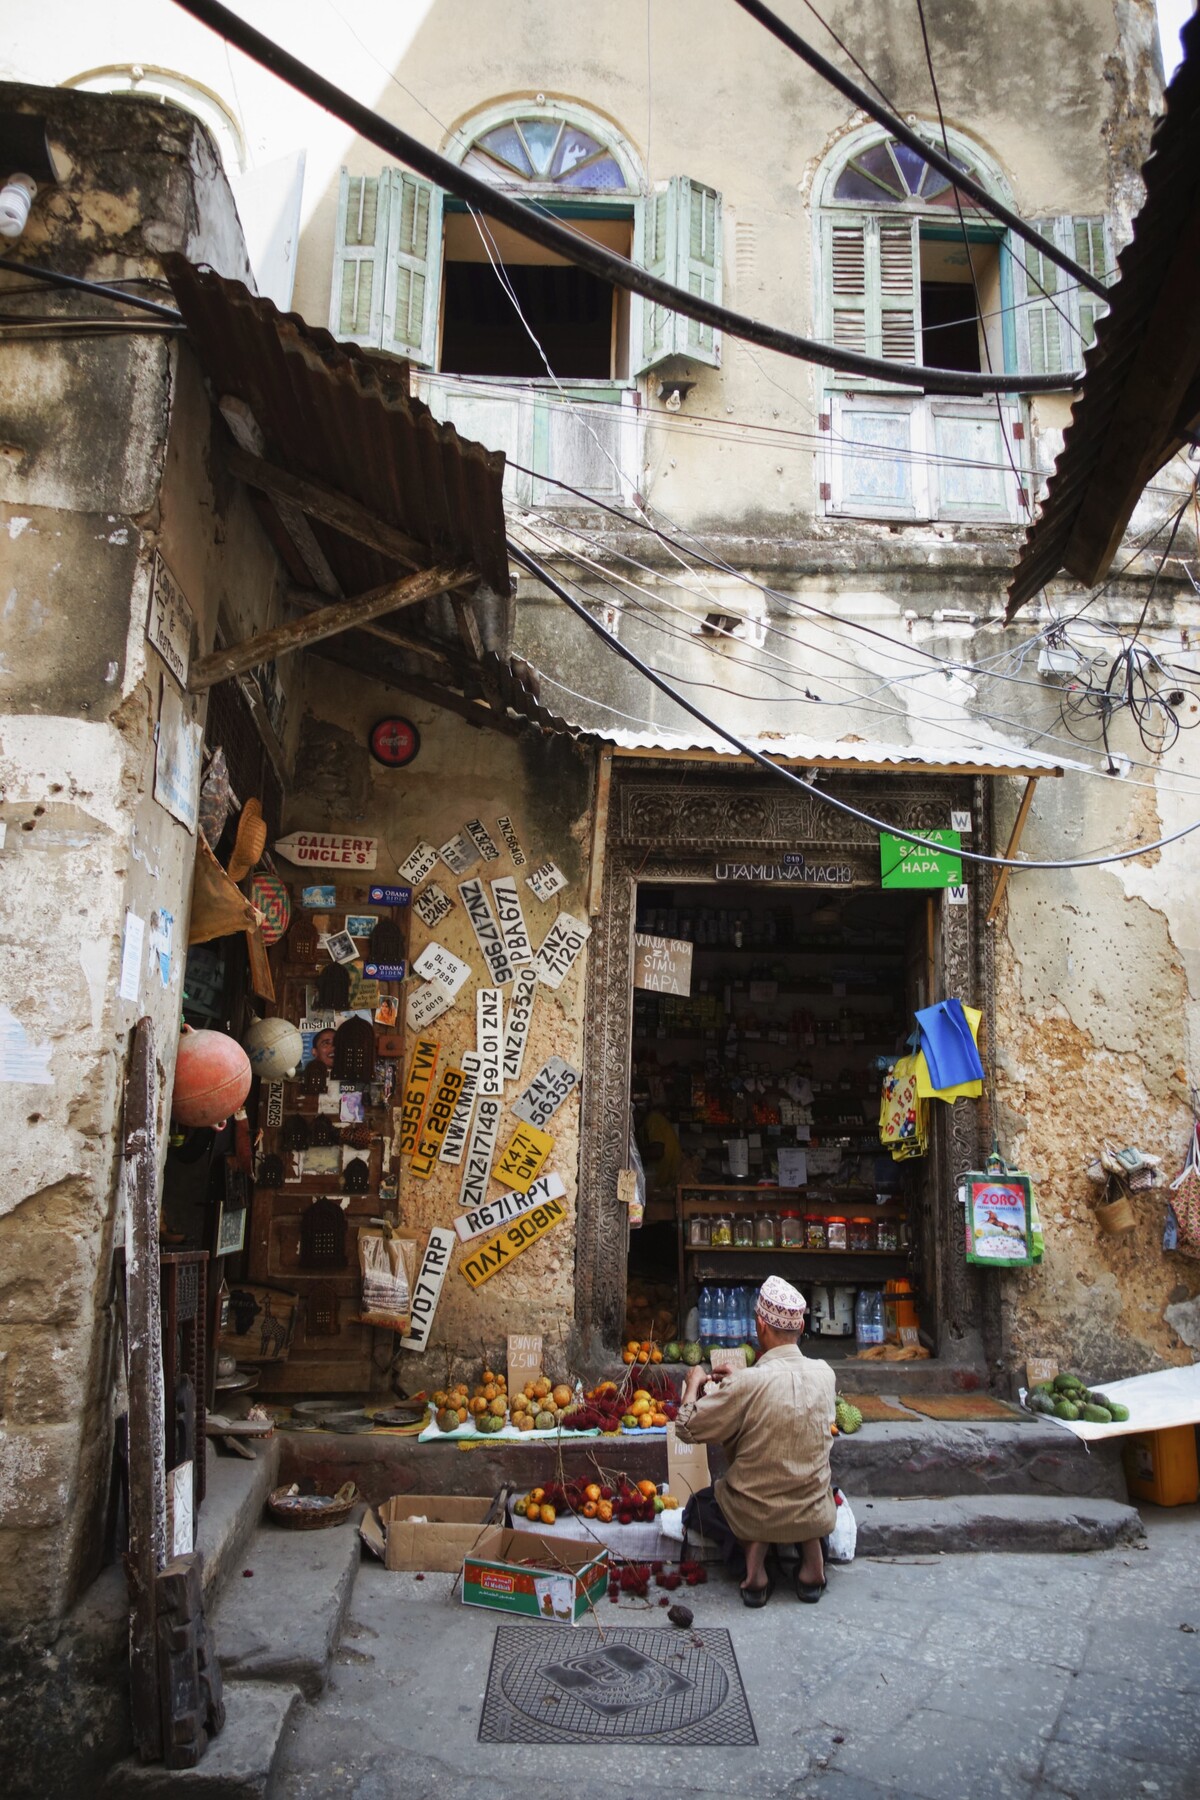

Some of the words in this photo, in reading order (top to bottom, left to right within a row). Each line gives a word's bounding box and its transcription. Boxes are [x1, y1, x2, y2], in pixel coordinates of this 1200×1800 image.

[953, 813, 968, 828] W
[297, 835, 373, 852] GALLERY
[405, 849, 425, 871] ZNZ
[411, 850, 441, 885] 20832
[901, 861, 940, 873] HAPA
[385, 889, 409, 898] OBAMA
[951, 886, 965, 899] W
[536, 925, 568, 965] ZNZ
[549, 930, 586, 977] 71201
[379, 964, 403, 972] OBAMA
[643, 954, 676, 973] SIMU
[644, 972, 680, 994] HAPA
[425, 995, 445, 1013] 6019
[411, 1041, 438, 1084] TVM
[527, 1067, 557, 1106] ZNZ
[529, 1069, 576, 1126] 56355
[411, 1141, 439, 1174] LG
[427, 1071, 462, 1135] 2889
[982, 1193, 1018, 1206] ZORO
[466, 1197, 513, 1233] R671
[422, 1236, 448, 1277] TRP
